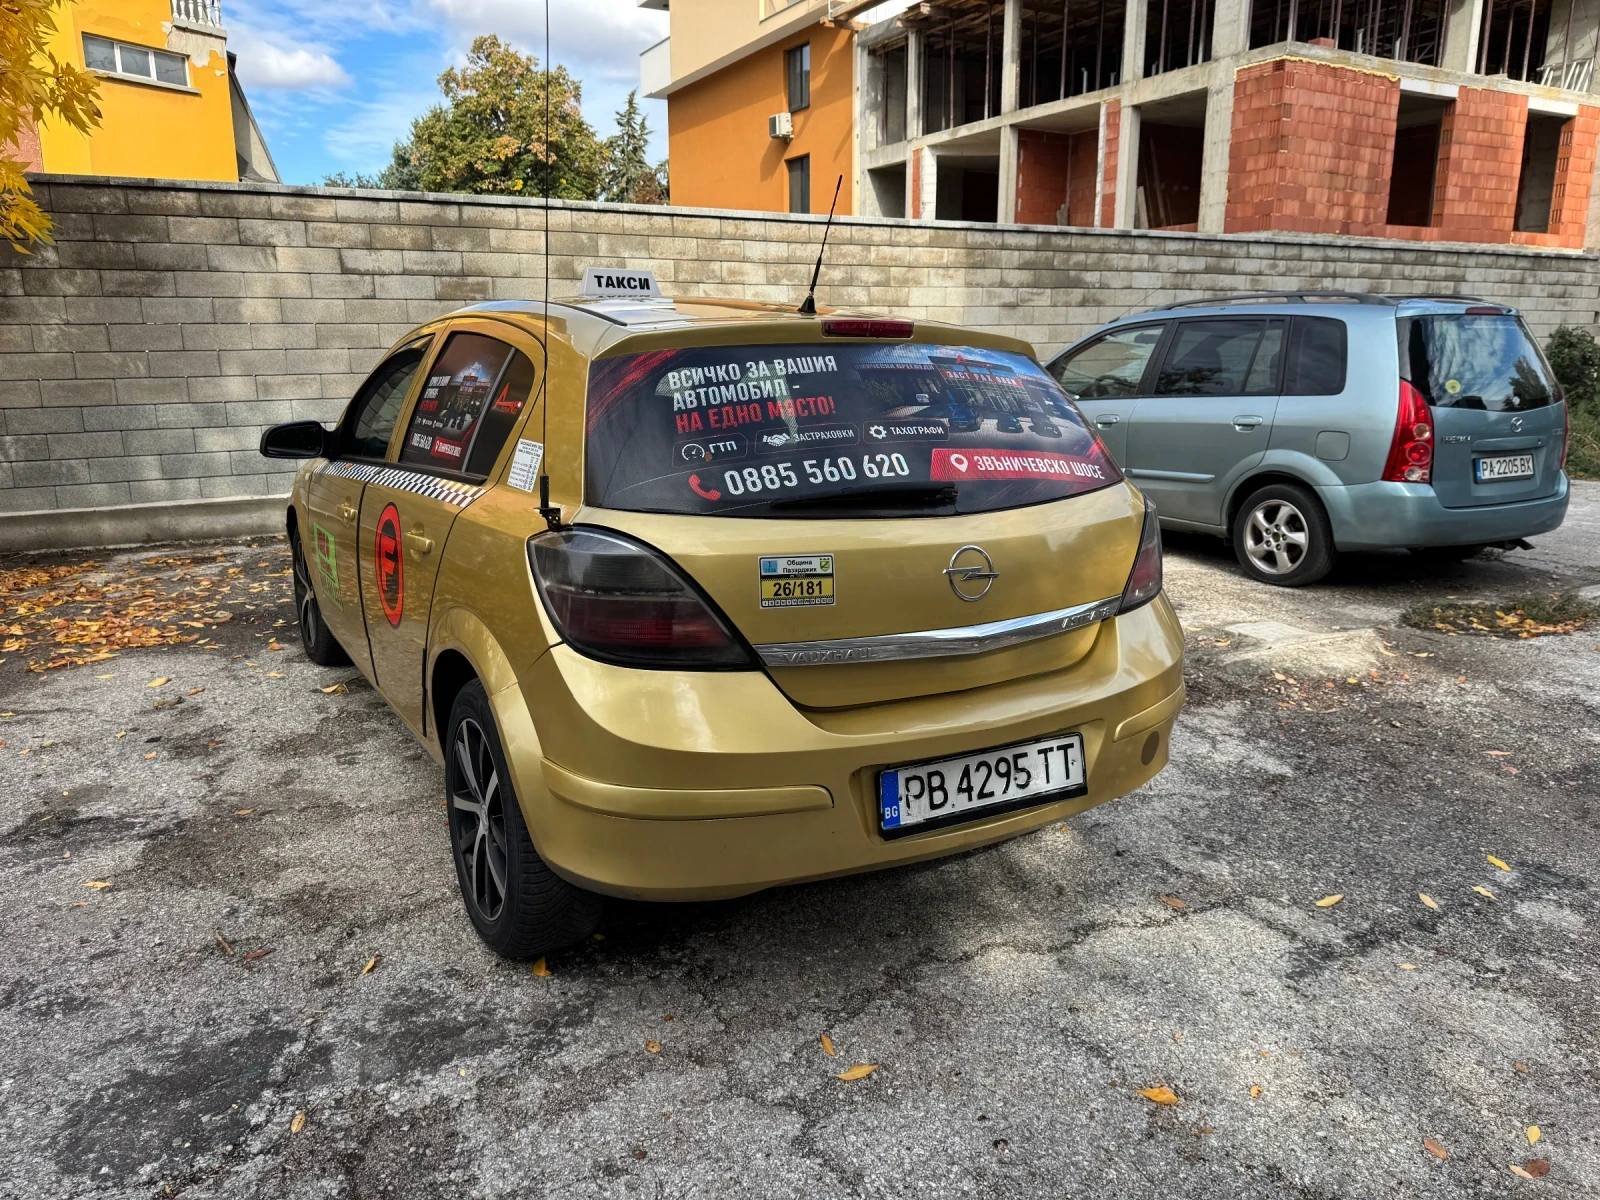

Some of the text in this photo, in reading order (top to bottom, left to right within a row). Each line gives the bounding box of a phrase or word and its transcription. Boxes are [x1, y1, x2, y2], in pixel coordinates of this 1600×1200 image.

[593, 274, 651, 290] ТАКСИ
[667, 355, 838, 390] ВСИЧКО ЗА ВАШИЯ
[672, 378, 787, 412] АВТОМОБИЛ
[675, 395, 836, 434] НА ЕДНО МЯСТО!
[793, 428, 855, 443] ЗАСТРАХОВКИ
[889, 426, 945, 436] ТАХОГРАФИ
[708, 440, 738, 454] ГТП
[724, 453, 910, 496] 0885 560 620
[974, 456, 1106, 480] ЗВЪНИЧЕВСКО ШОСЕ
[1496, 458, 1519, 475] 2205
[1520, 457, 1532, 473] BX
[773, 580, 823, 597] 26/181
[782, 647, 877, 663] VAUXHALL
[905, 742, 1075, 812] PB 4295 TT
[884, 806, 898, 819] BG
